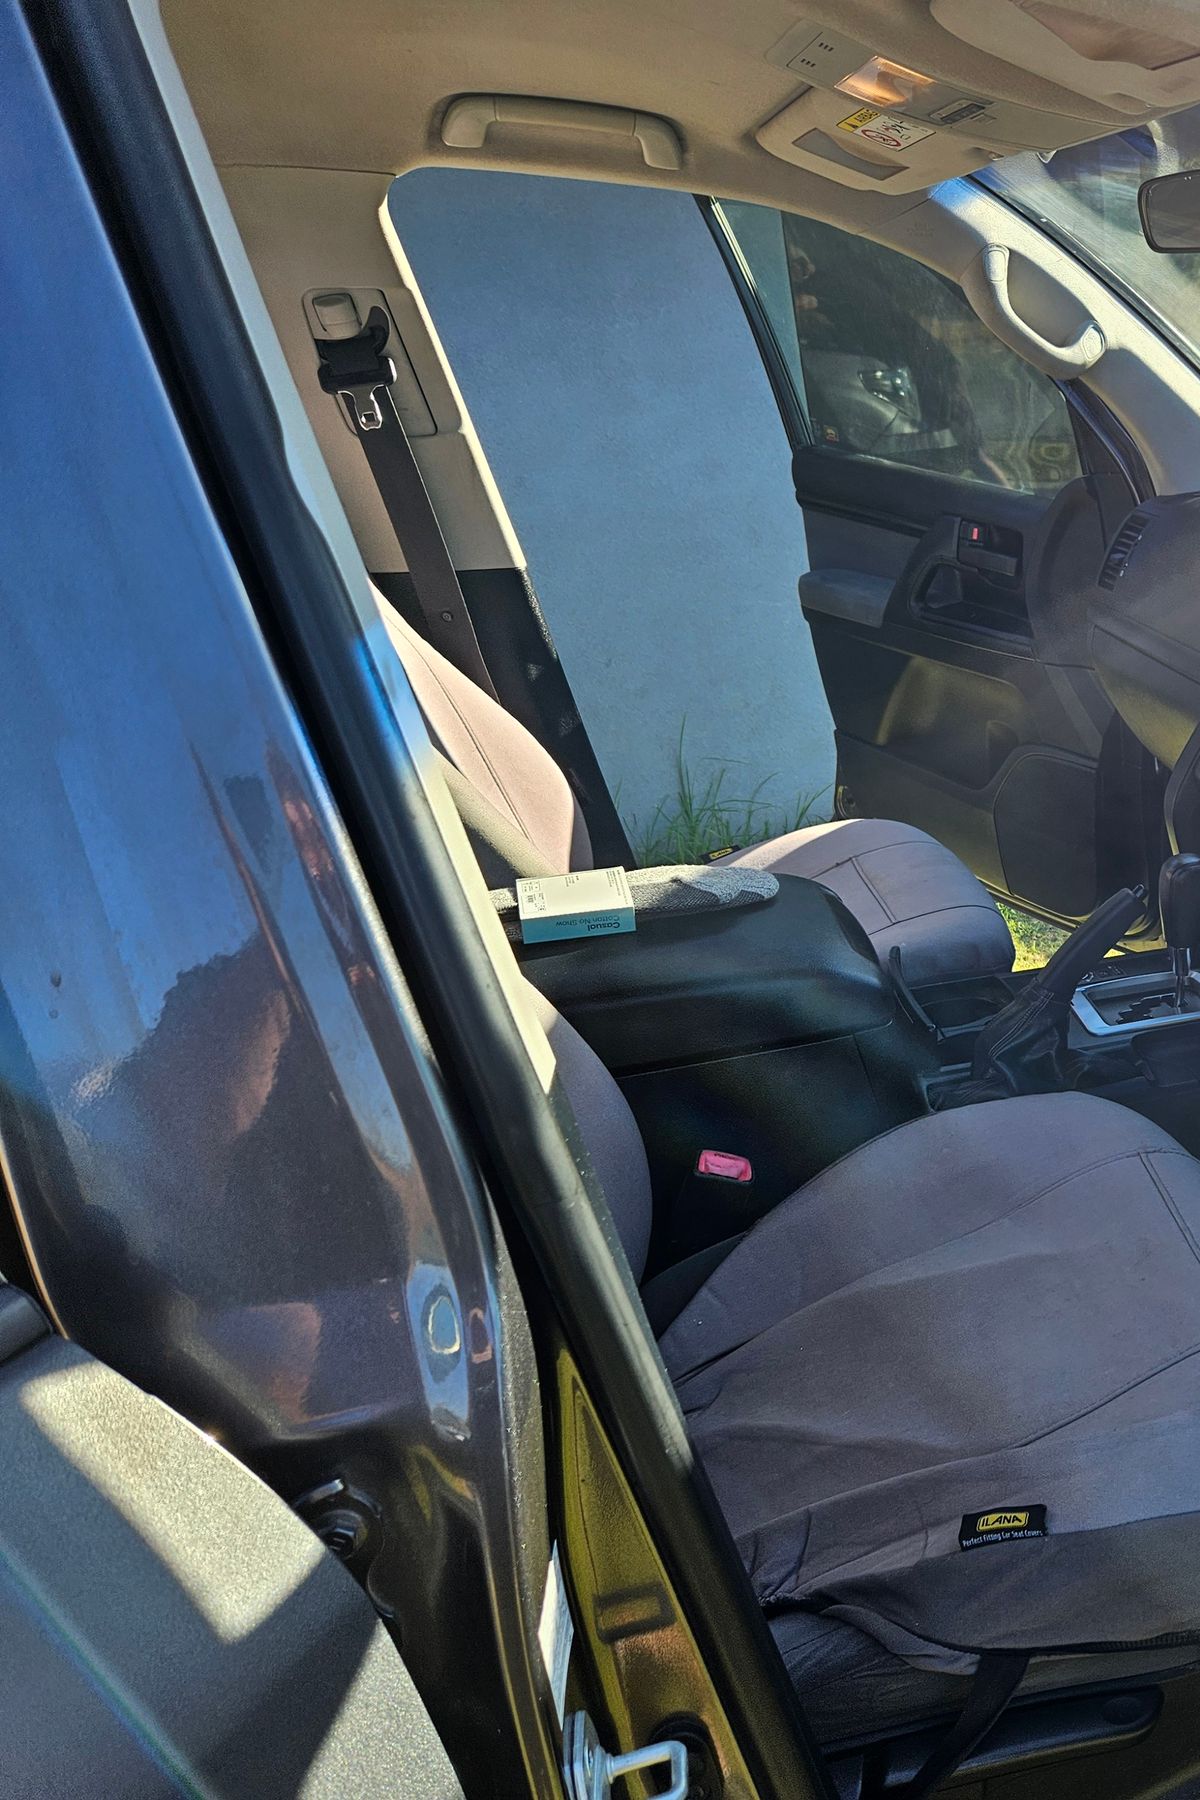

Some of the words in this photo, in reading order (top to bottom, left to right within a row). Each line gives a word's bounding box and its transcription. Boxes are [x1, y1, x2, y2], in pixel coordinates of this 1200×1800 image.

[555, 919, 577, 927] Show
[587, 922, 620, 931] Casual
[981, 1515, 1022, 1527] ILANA
[962, 1536, 982, 1547] Perfect
[983, 1533, 1001, 1542] Fitting
[1001, 1531, 1010, 1539] Car
